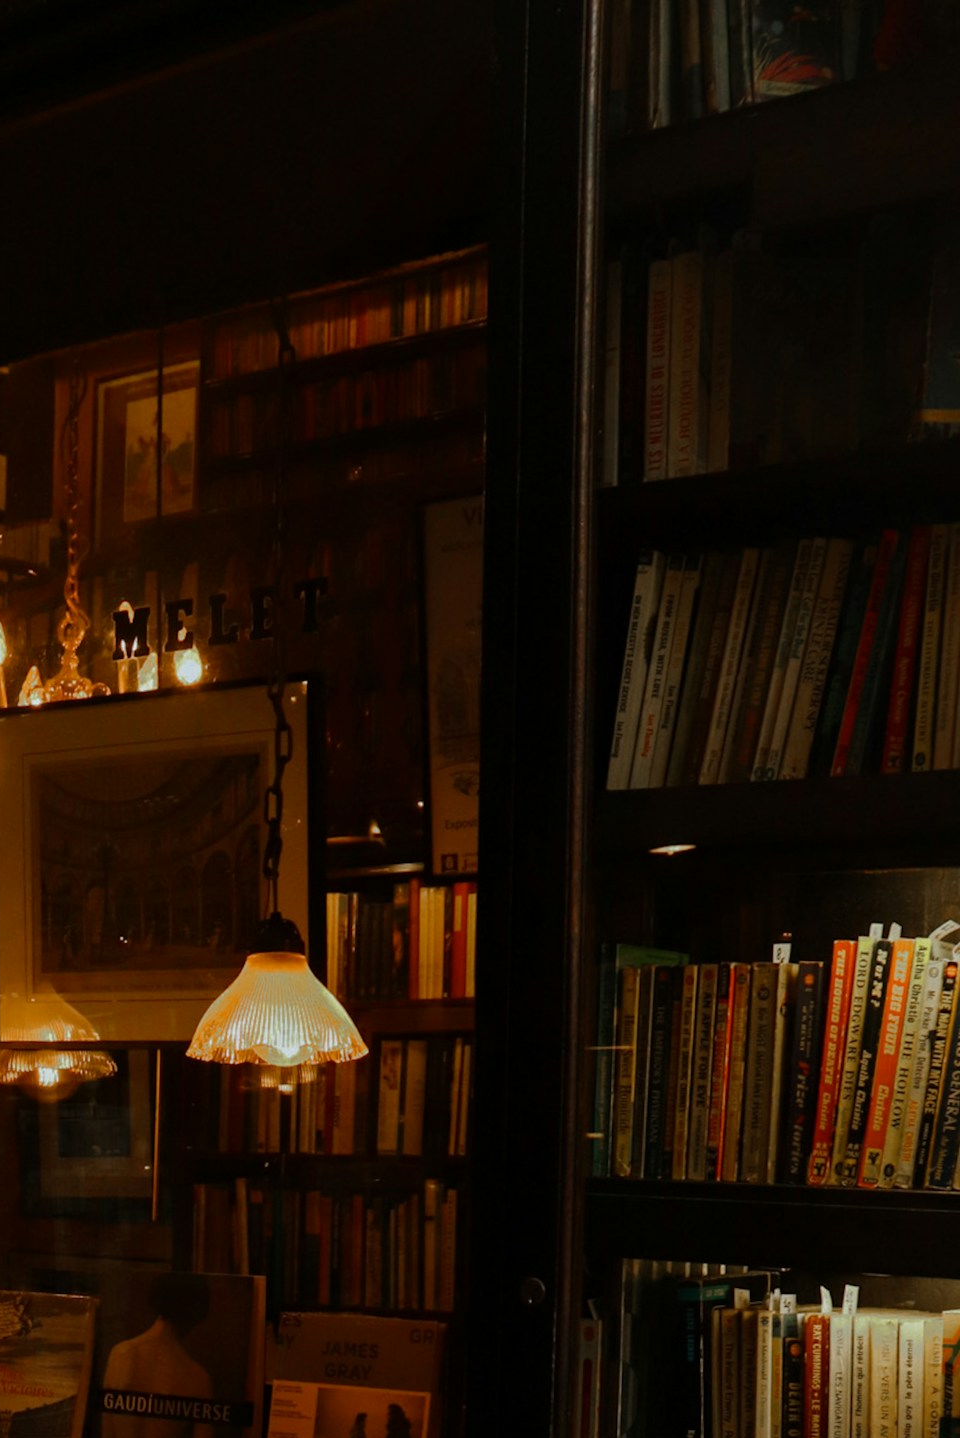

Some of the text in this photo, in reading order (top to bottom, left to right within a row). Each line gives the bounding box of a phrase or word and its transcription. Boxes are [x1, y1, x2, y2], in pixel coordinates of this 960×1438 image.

[112, 576, 330, 661] MELET
[802, 706, 819, 734] SPY
[698, 1012, 711, 1051] APPLE
[819, 949, 847, 1131] THE HOUND OF DEATH Christie
[842, 951, 870, 1100] LORD EDGWARE DIES
[872, 949, 909, 1131] THE BIG FOUR Christie
[891, 944, 929, 1131] Agatha Christie THE HOLLOW
[696, 1055, 709, 1080] FOR
[923, 989, 954, 1116] THE MAN WITH MY FACE
[695, 1084, 707, 1107] EVE
[794, 1060, 812, 1109] Prize
[851, 1049, 873, 1131] Agatha Christie
[321, 1341, 380, 1360] JAMES
[812, 1323, 823, 1342] RAY
[323, 1363, 373, 1381] GRAY
[811, 1342, 823, 1390] CUMMINGS
[811, 1399, 822, 1411] LE
[881, 1375, 890, 1401] VERS
[881, 1405, 890, 1420] UN
